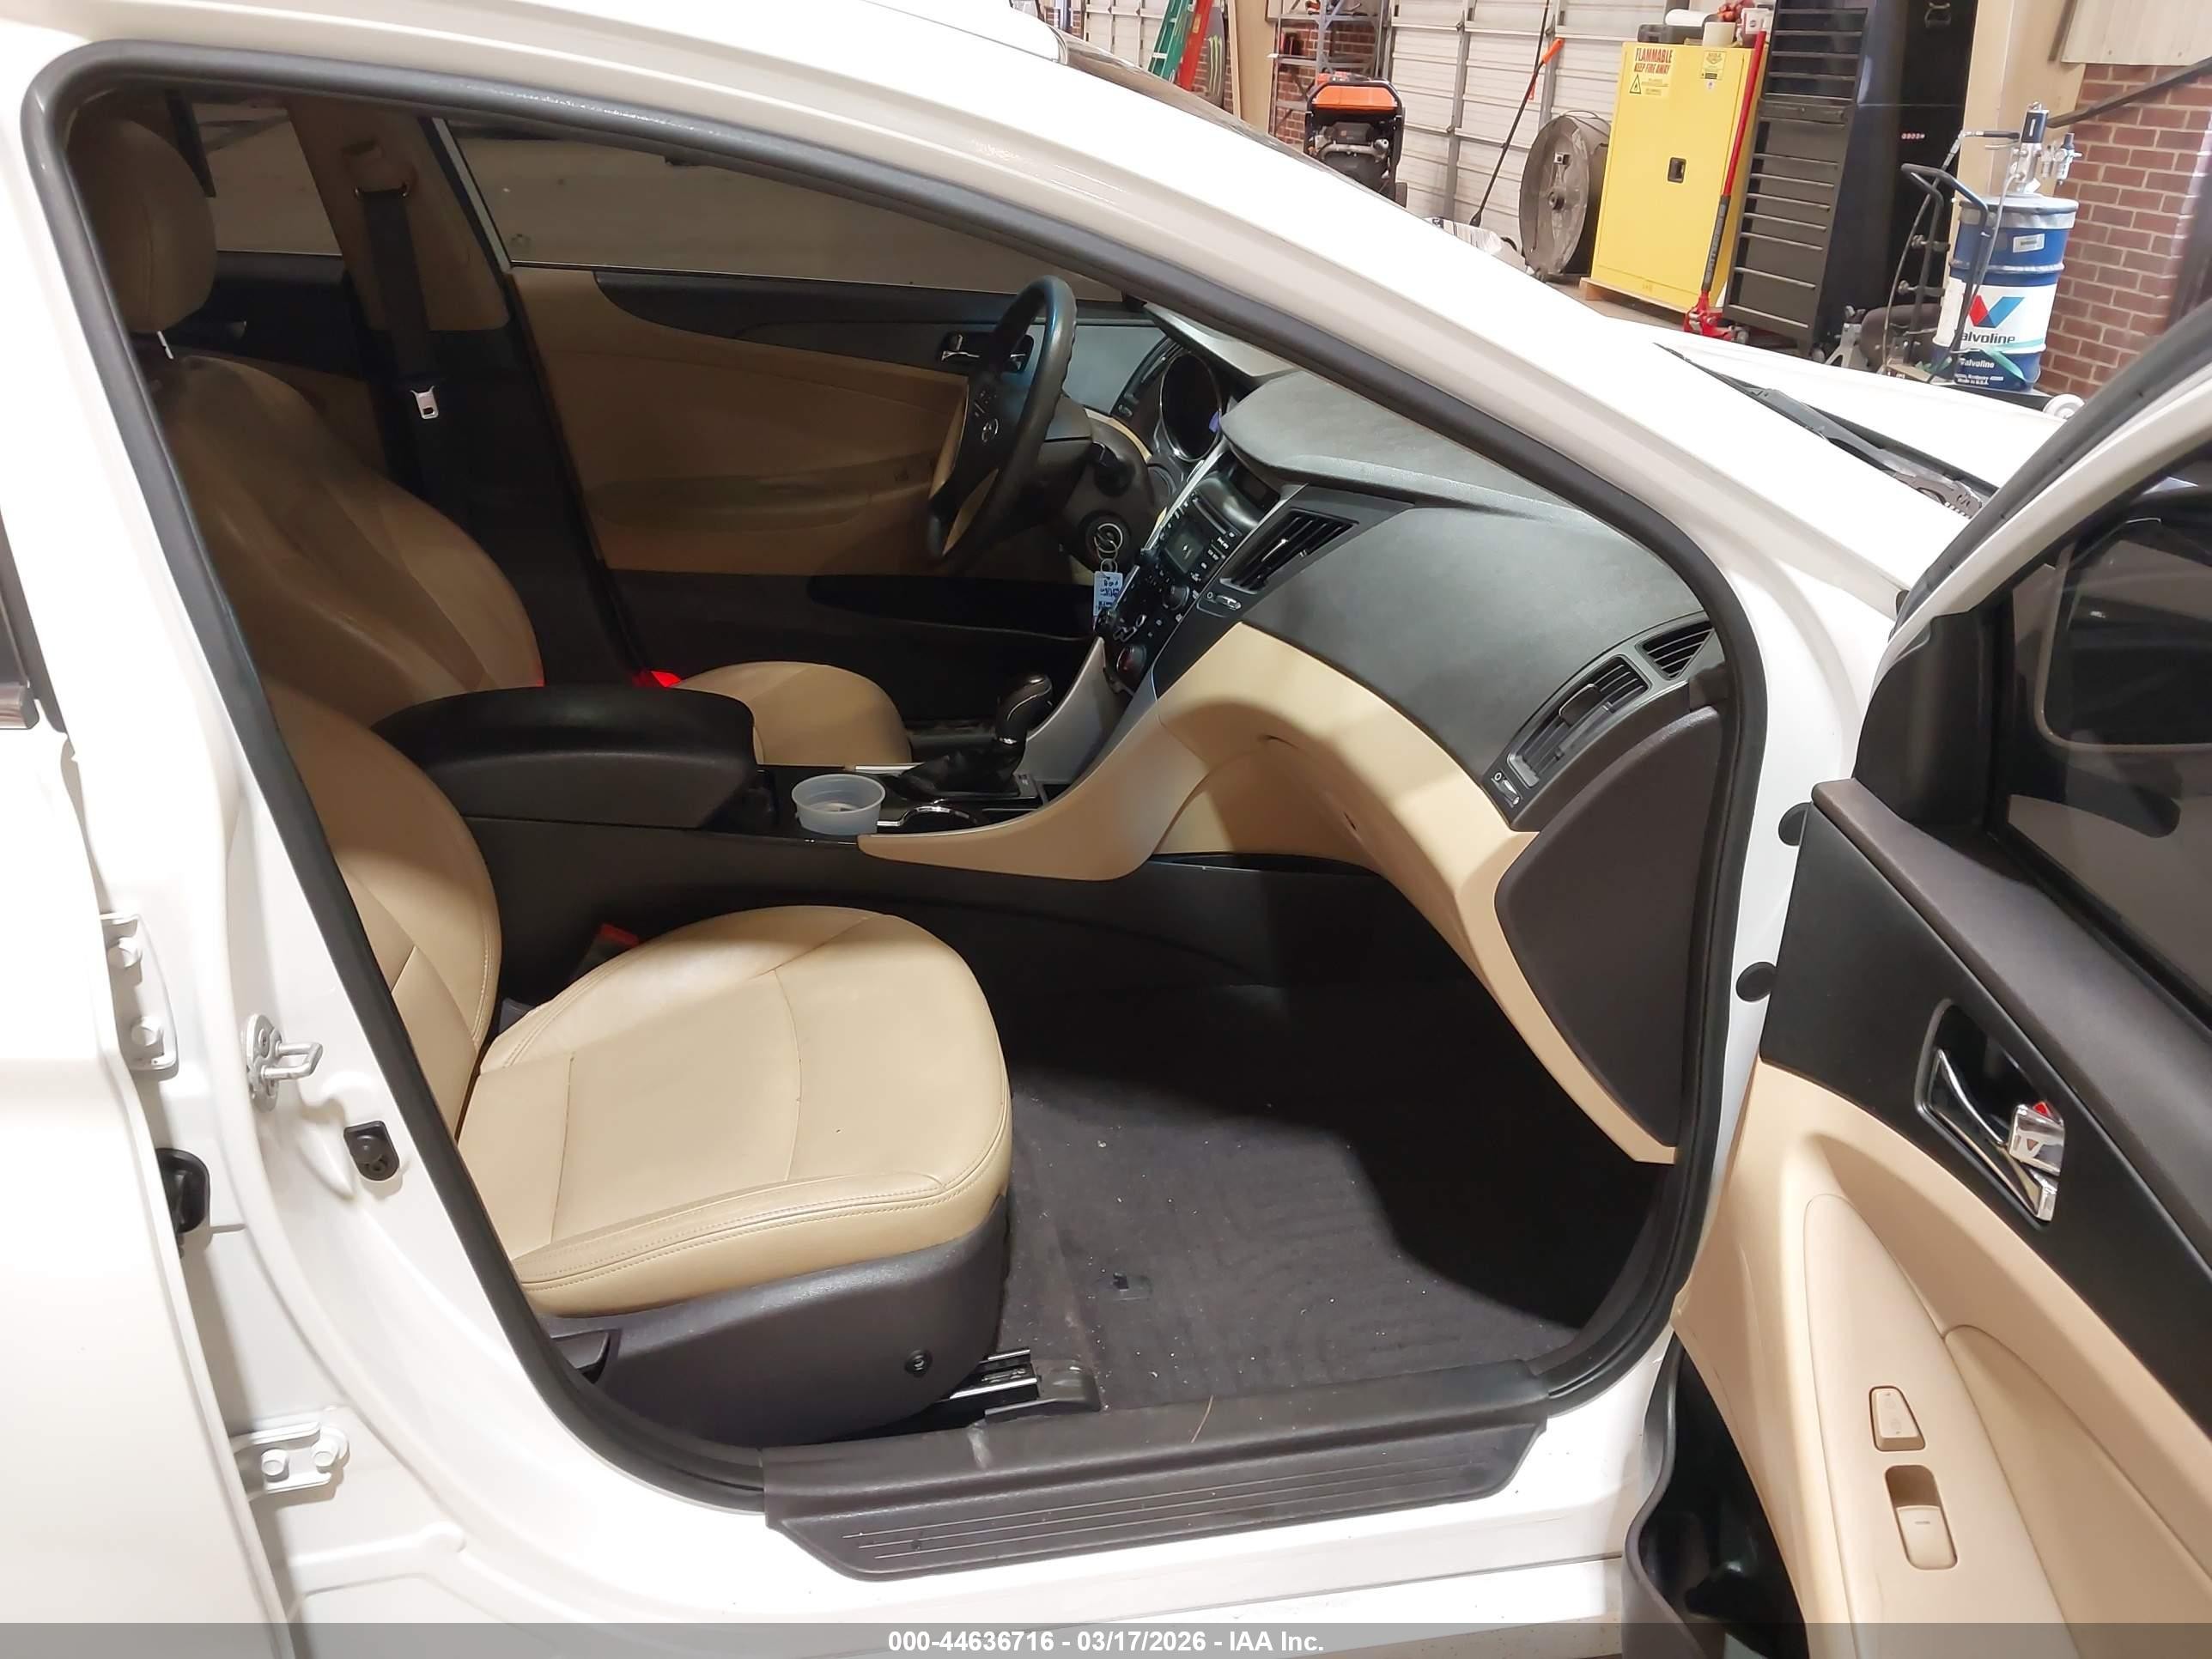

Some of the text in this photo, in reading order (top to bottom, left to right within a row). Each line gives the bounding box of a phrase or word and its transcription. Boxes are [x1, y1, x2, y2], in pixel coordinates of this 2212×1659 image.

[1635, 47, 1674, 64] FLAMMABLE
[1633, 63, 1671, 75] KEEP FIRE AWAY
[1961, 331, 2015, 344] alvoline
